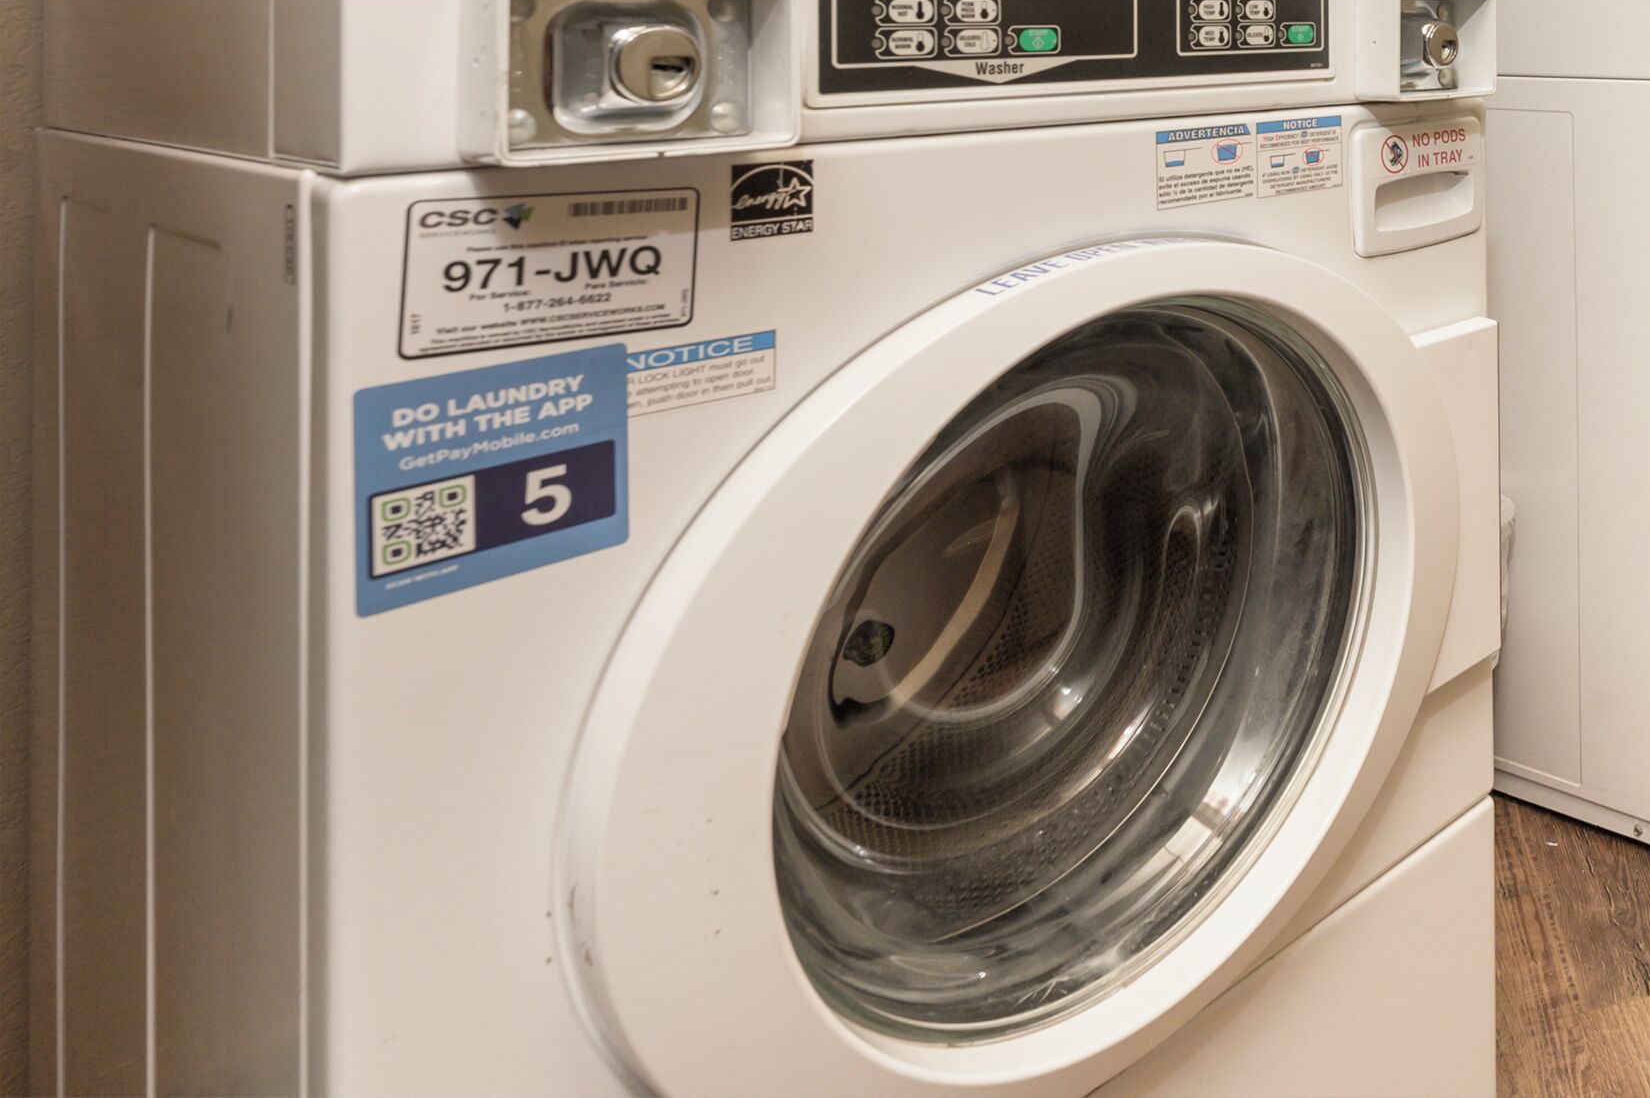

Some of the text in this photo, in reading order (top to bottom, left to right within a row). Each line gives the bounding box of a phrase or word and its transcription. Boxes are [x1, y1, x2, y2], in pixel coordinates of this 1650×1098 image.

[976, 62, 1024, 75] Washer
[1168, 126, 1244, 141] ADVERTENCIA
[1284, 118, 1318, 129] NOTICE
[1412, 128, 1466, 147] NO PODS
[1418, 150, 1463, 168] IN TRAY
[419, 208, 498, 228] CSC
[732, 220, 812, 239] ENERGY STAR
[443, 245, 661, 292] 971-JWQ
[975, 260, 1069, 296] LEAVE
[626, 335, 753, 370] NOTICE
[637, 371, 670, 384] LOCK
[708, 361, 733, 372] must
[735, 360, 748, 369] go
[750, 355, 765, 365] out
[692, 378, 702, 386] to
[704, 375, 730, 386] open
[392, 374, 585, 428] DO LAUNDRY
[382, 394, 594, 452] WITH THE APP
[398, 422, 579, 471] GetPayMobile.com
[521, 464, 572, 526] 5
